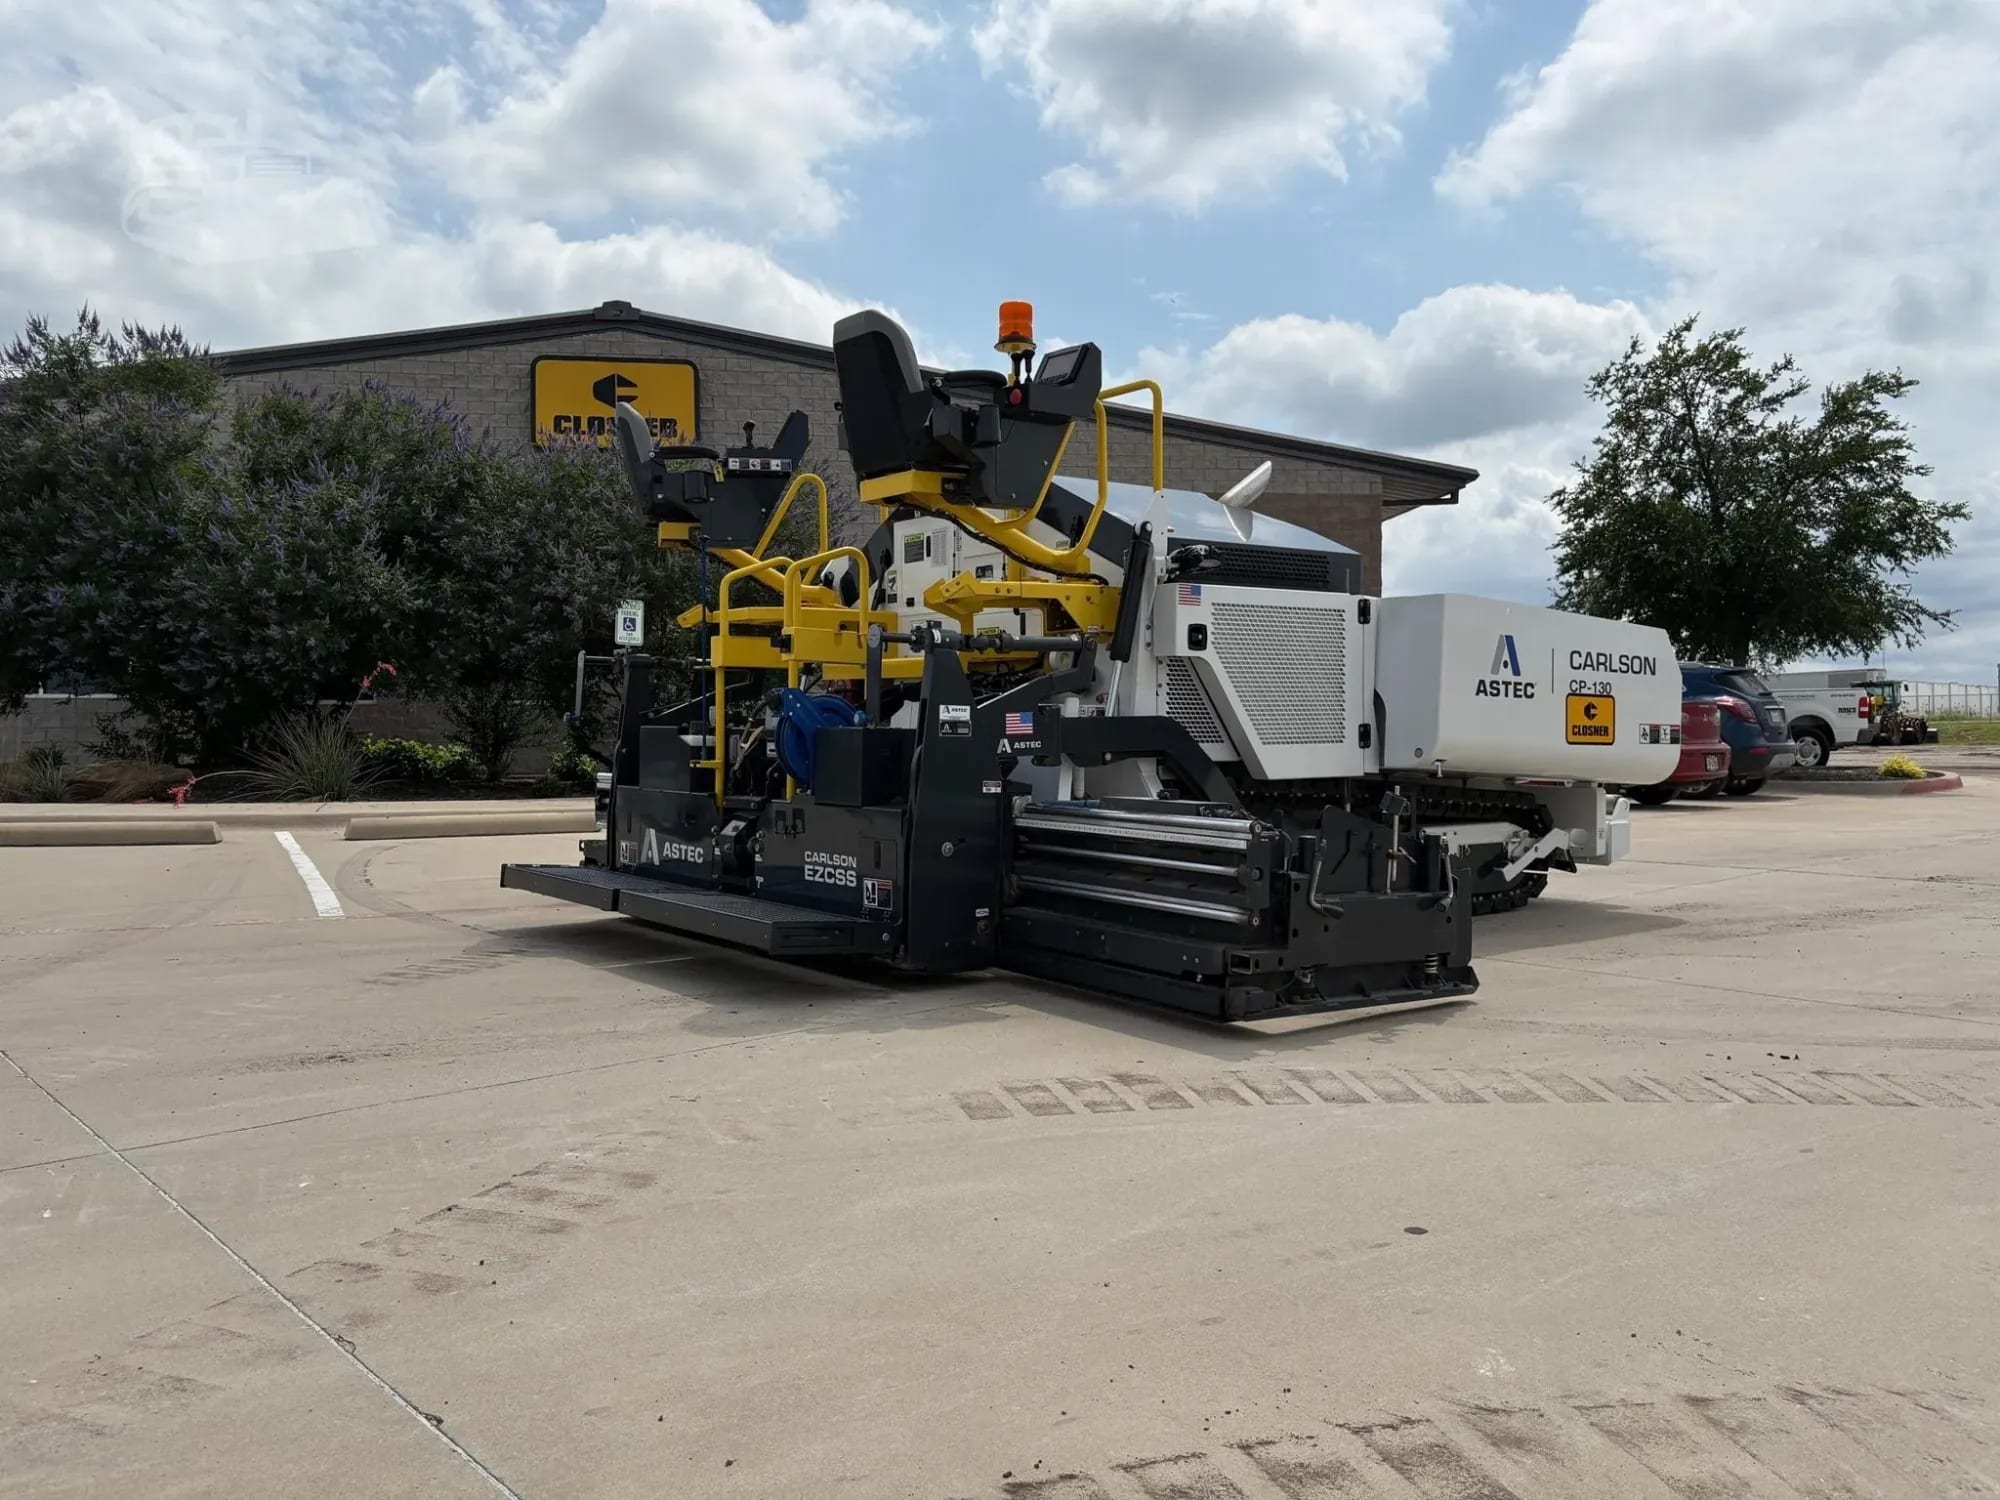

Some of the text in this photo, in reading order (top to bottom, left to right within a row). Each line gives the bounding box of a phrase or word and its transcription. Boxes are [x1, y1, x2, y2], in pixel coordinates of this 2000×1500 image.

[554, 415, 678, 438] CLOSER
[1569, 650, 1657, 676] CARLSON
[1475, 679, 1535, 699] ASTEC
[1569, 680, 1612, 695] CP-130
[1572, 725, 1609, 737] CLOSNER
[1013, 741, 1042, 749] ASTEC
[662, 841, 704, 864] ASTEC
[804, 851, 857, 868] CARLSON
[804, 864, 857, 888] EZCSS
